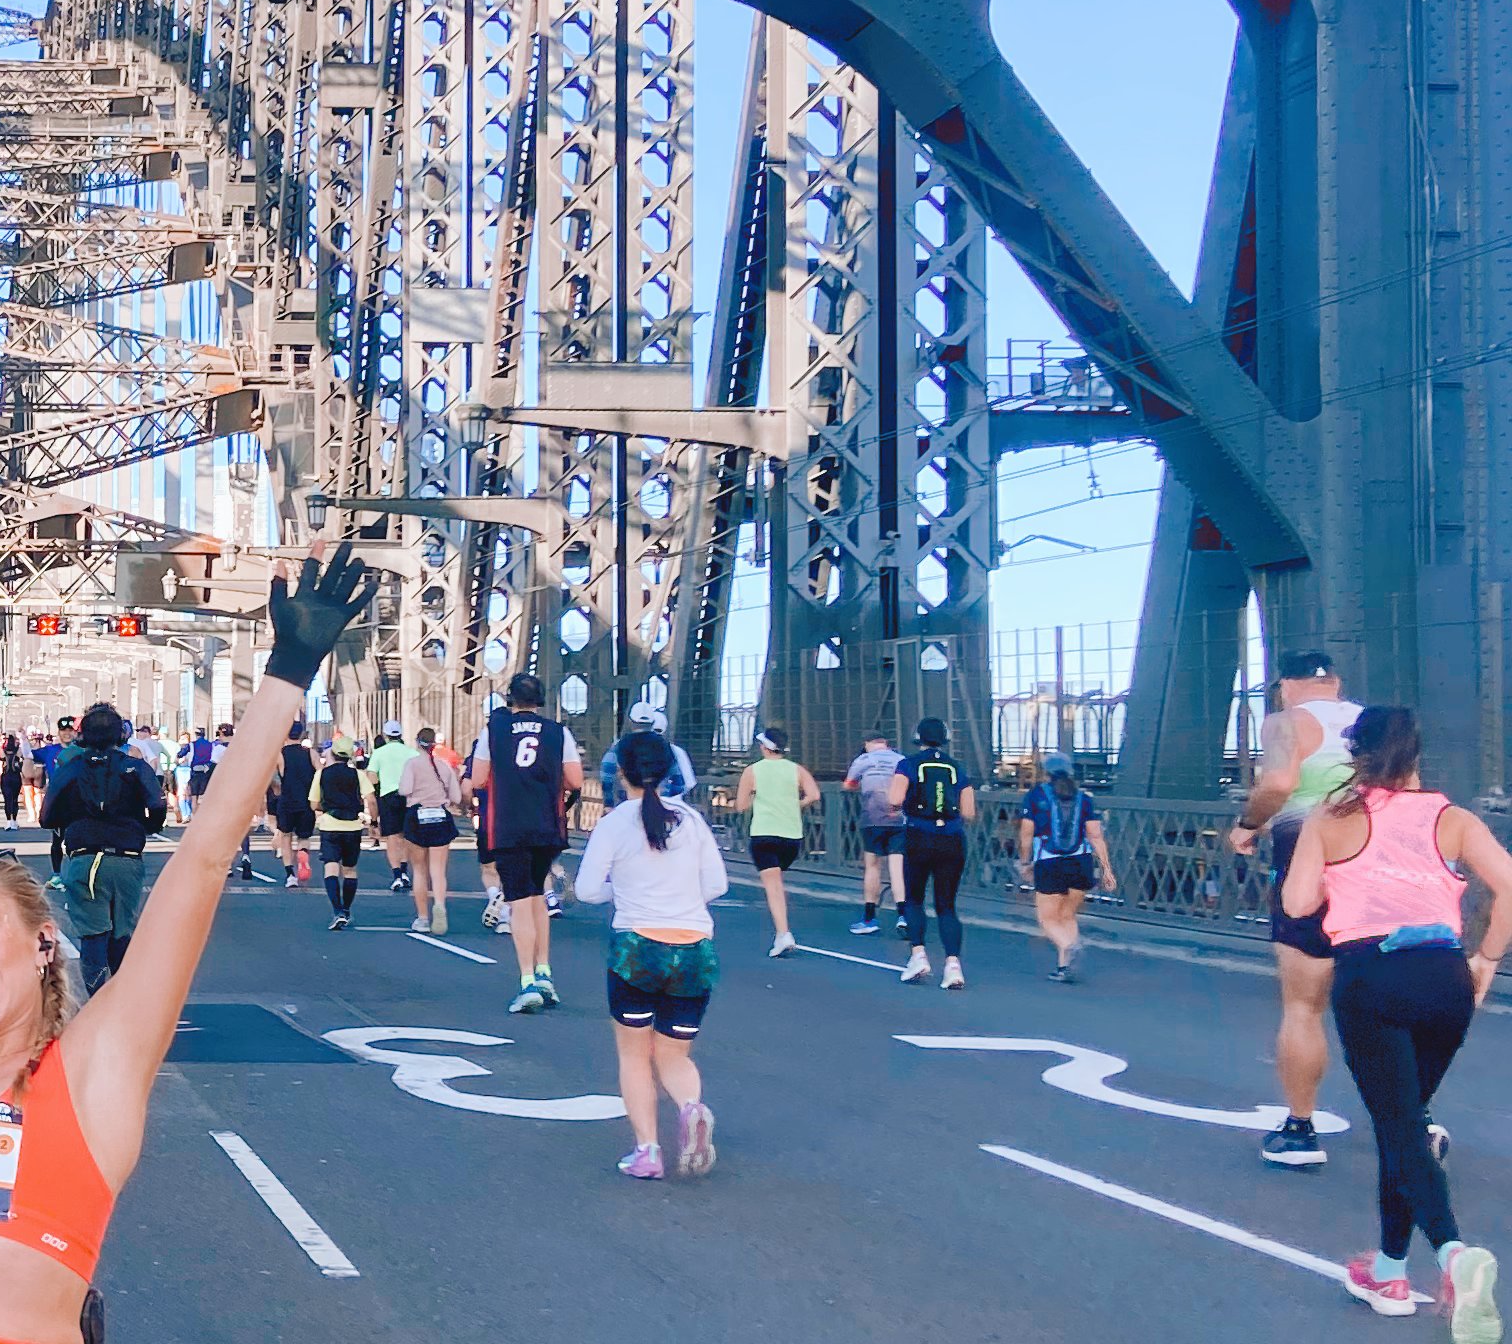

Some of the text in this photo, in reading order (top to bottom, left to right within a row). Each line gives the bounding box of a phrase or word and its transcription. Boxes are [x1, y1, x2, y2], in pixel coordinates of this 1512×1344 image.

[28, 619, 66, 631] 2 2
[511, 721, 542, 734] JAMES
[515, 736, 539, 768] 6
[0, 1139, 8, 1150] 2
